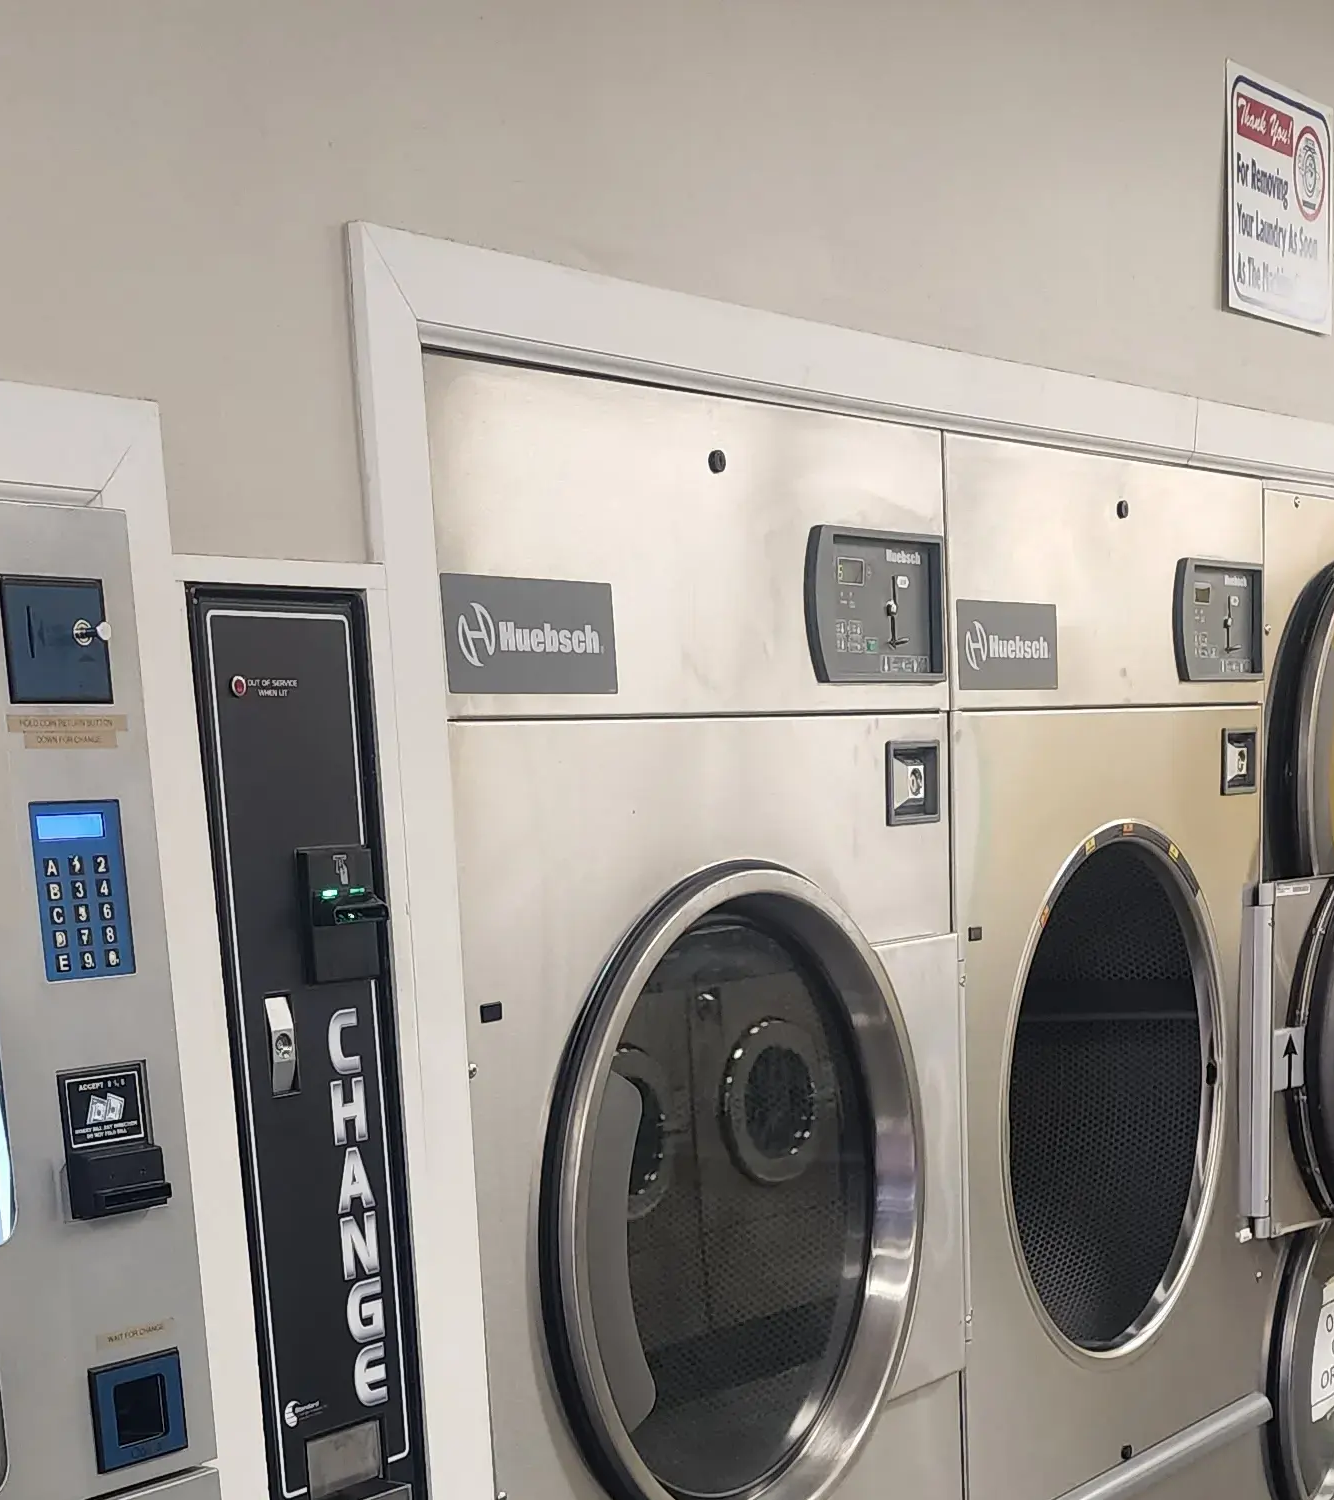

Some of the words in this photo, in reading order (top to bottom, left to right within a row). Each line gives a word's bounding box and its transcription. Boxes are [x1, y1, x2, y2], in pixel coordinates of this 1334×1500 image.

[1237, 97, 1267, 136] Thank
[1269, 113, 1292, 147] You!
[1236, 152, 1250, 187] For
[1251, 158, 1289, 210] Removing
[1237, 202, 1254, 240] Your
[1255, 210, 1286, 257] Laundry
[1289, 224, 1298, 255] As
[1237, 252, 1246, 285] As
[1247, 257, 1261, 289] The
[498, 621, 600, 654] Huebsch
[988, 634, 1049, 659] Huebsch
[248, 679, 260, 687] OUT
[262, 679, 270, 687] OF
[272, 679, 298, 687] SERVICE
[258, 689, 277, 697] WHEN
[47, 860, 58, 876] A
[97, 856, 106, 873] 2
[49, 883, 60, 900] B
[75, 882, 84, 898] 3
[100, 880, 109, 896] 4
[53, 907, 63, 923] C
[103, 904, 111, 919] 6
[106, 927, 114, 942] 8
[59, 955, 69, 971] E
[78, 1082, 104, 1092] ACCEPT
[327, 1007, 389, 1407] CHANGE
[108, 1332, 124, 1344] WAIT
[124, 1328, 139, 1340] FOR
[139, 1322, 165, 1336] CHANGE
